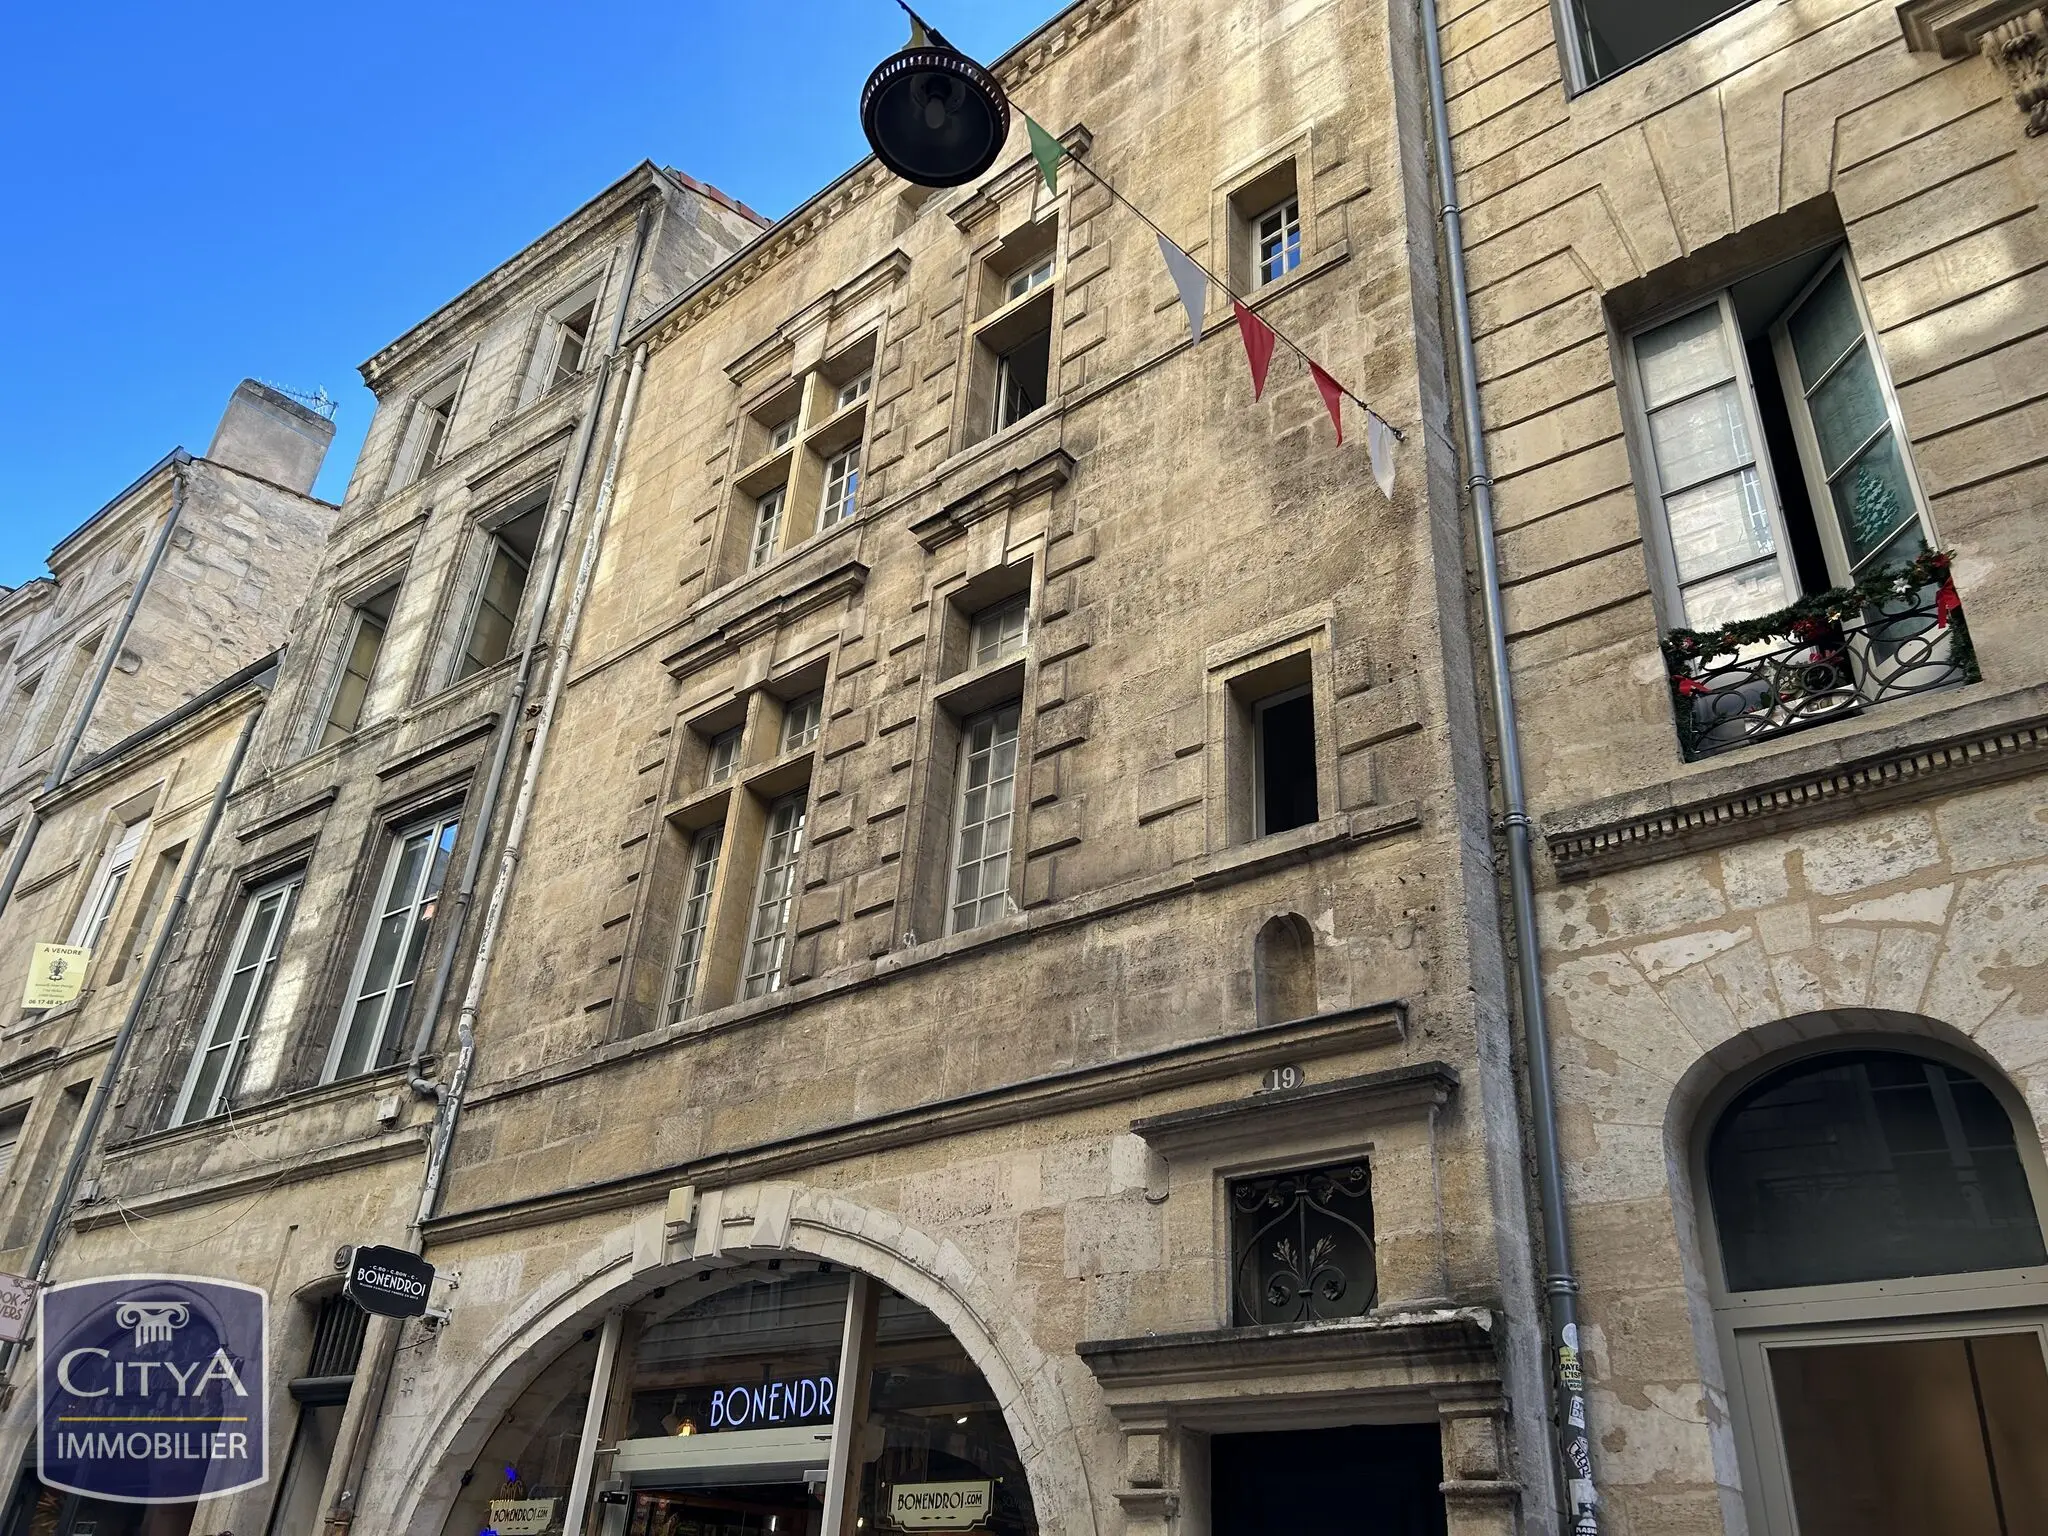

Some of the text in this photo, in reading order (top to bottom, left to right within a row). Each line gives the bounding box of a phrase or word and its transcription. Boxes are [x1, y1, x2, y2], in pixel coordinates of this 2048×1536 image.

[52, 947, 83, 956] VENDRE
[1271, 1066, 1296, 1091] 19
[356, 1267, 427, 1297] BONENDROI
[0, 1289, 21, 1306] OK
[710, 1376, 834, 1427] BONENDR
[897, 1491, 983, 1511] BONENDROI.COM
